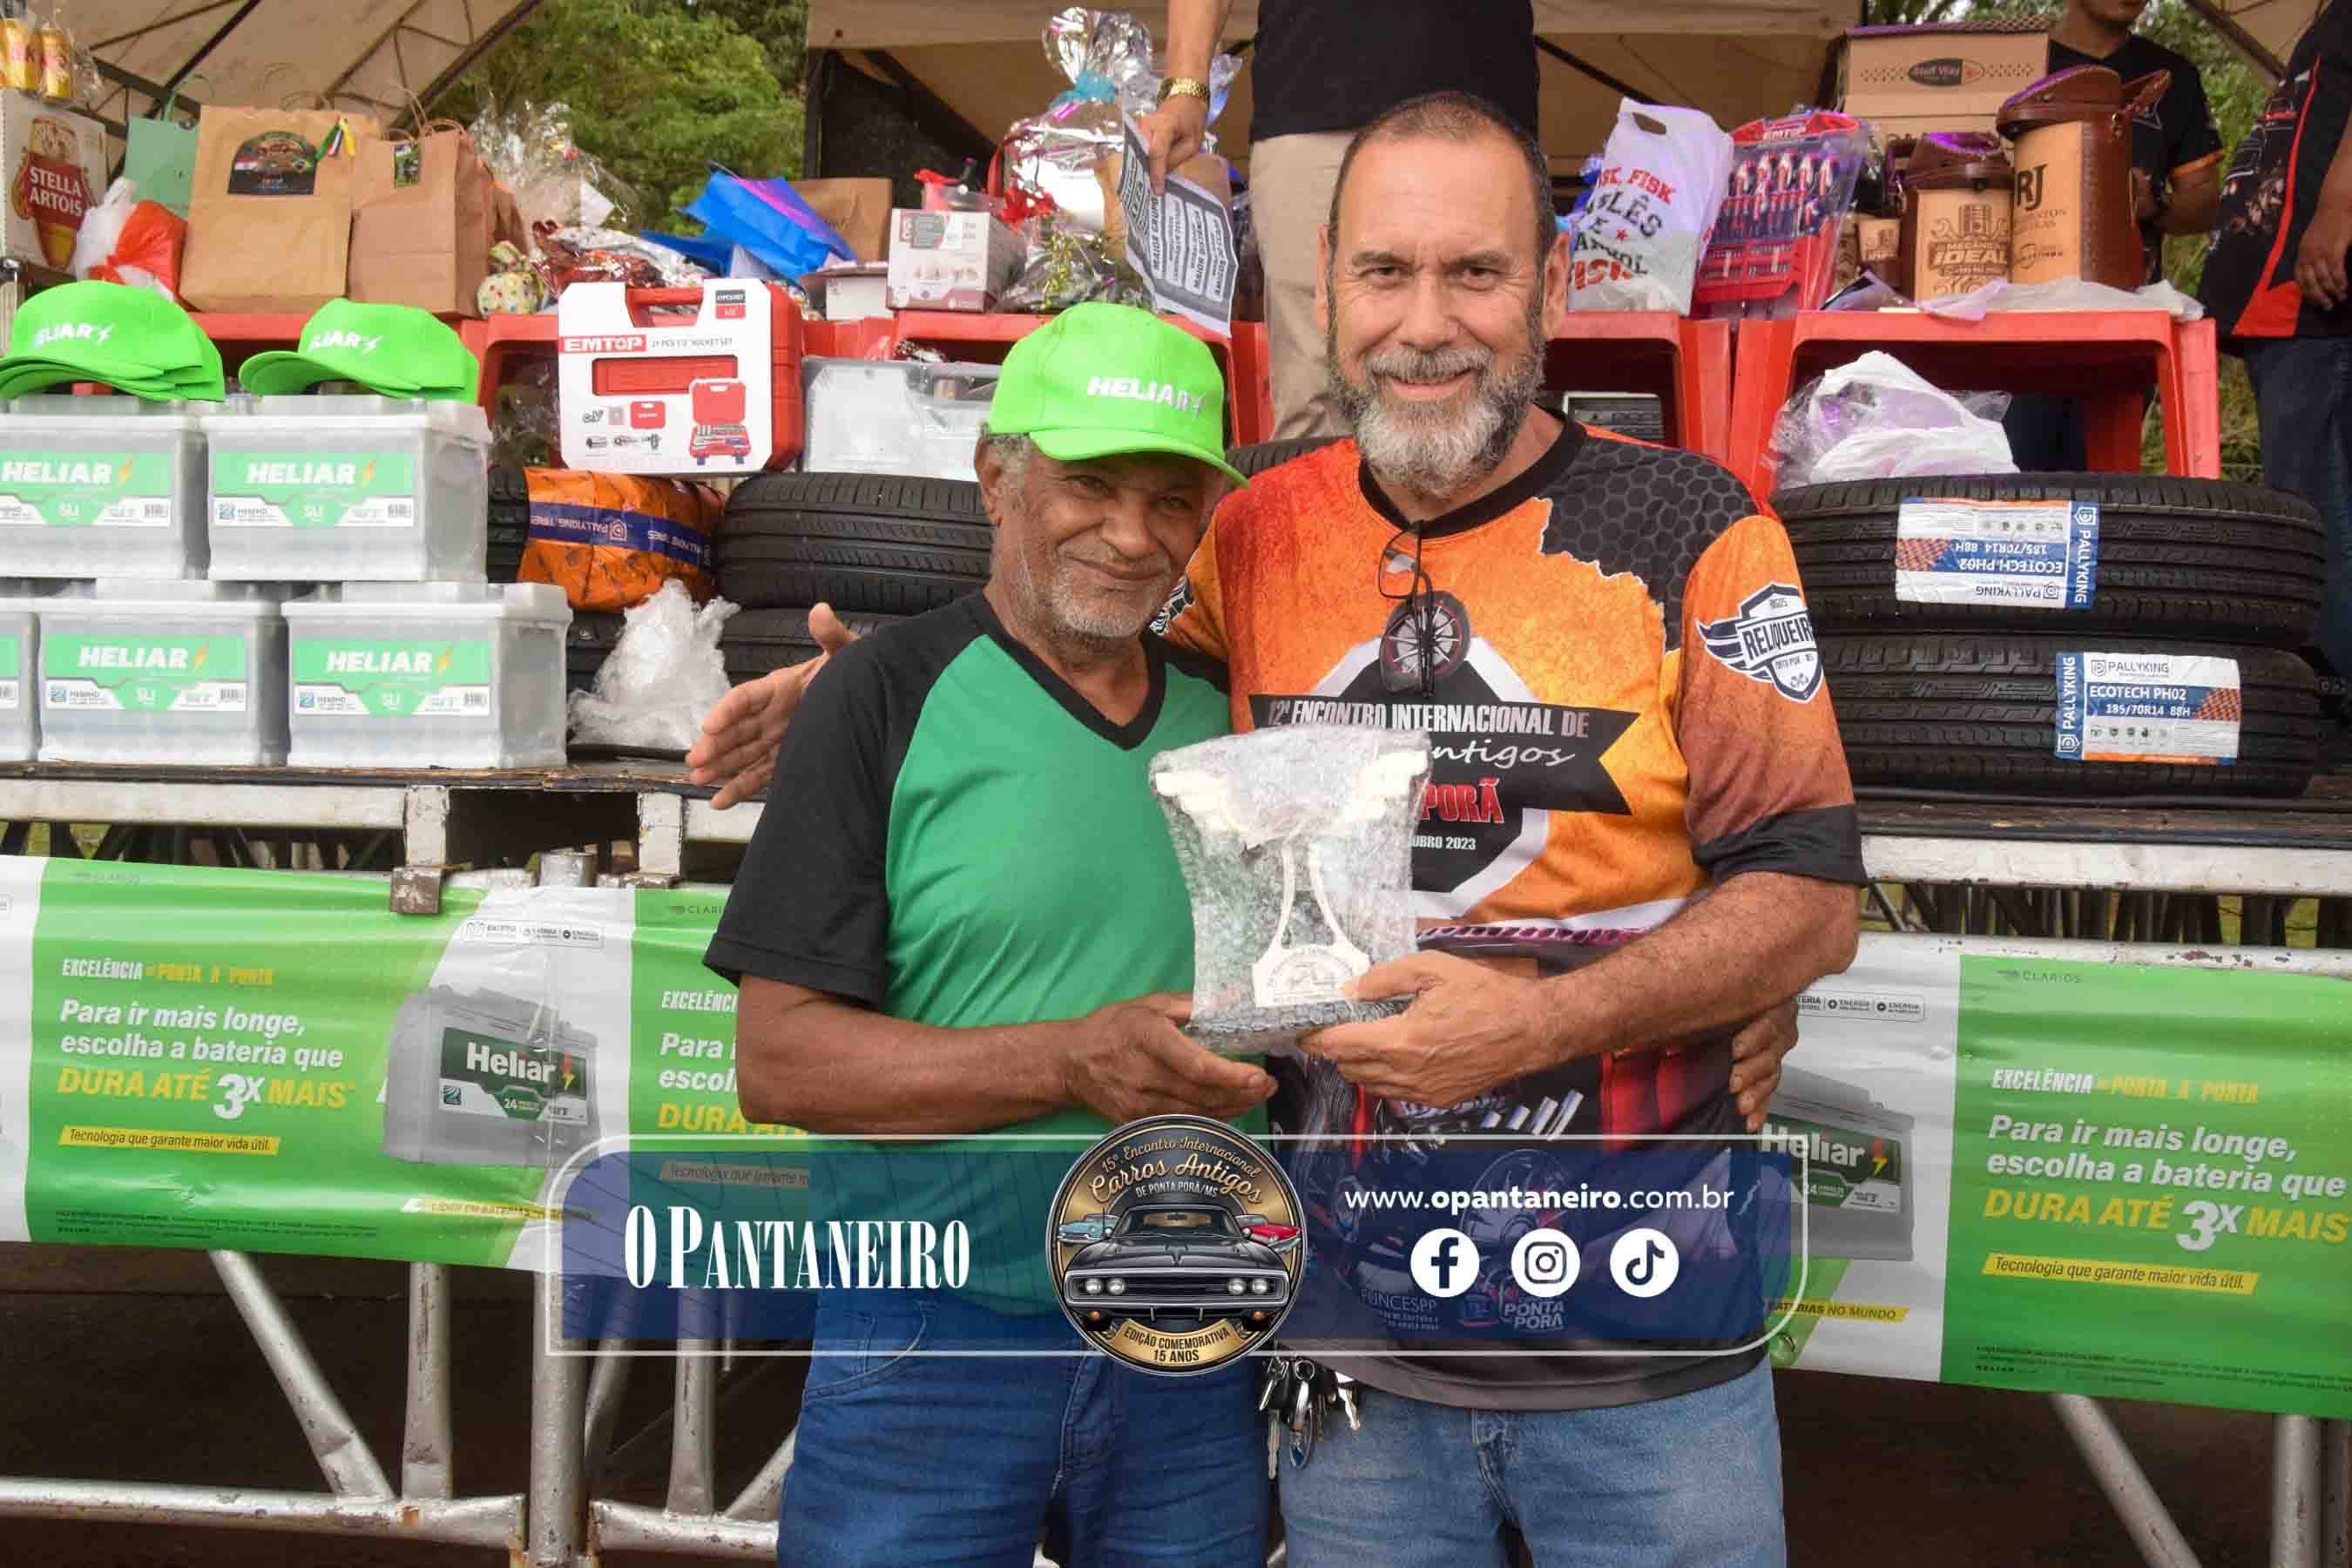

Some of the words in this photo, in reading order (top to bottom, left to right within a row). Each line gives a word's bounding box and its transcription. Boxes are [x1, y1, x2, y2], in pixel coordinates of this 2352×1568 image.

[30, 167, 82, 197] STELLA
[1628, 167, 1673, 206] FISK
[2017, 163, 2048, 211] RJ
[29, 187, 84, 216] ARTOIS
[564, 336, 642, 353] EMTOP
[1087, 375, 1188, 411] HELIAR
[2, 461, 112, 485] HELIAR
[247, 461, 356, 484] HELIAR
[1956, 542, 1978, 551] 88H
[1985, 543, 2046, 555] 185/70R14
[1960, 558, 1995, 570] PH02
[1999, 558, 2063, 573] ECOTECH
[2075, 529, 2092, 604] PALLYKING
[1976, 585, 2040, 598] PALLYKING
[1742, 617, 1813, 660] RELIQUEIR
[78, 645, 189, 669] HELIAR
[327, 651, 433, 673] HELIAR
[2108, 661, 2169, 673] PALLYKING
[2063, 657, 2077, 729] PALLYKING
[2091, 686, 2150, 699] ECOTECH
[2153, 687, 2187, 700] PH02
[1292, 700, 1387, 727] ENCONTRO
[1392, 704, 1555, 736] INTERNACIONAL
[1561, 712, 1589, 738] DE
[2105, 703, 2165, 716] 185/70R14
[2170, 706, 2190, 716] 88H
[1431, 739, 1576, 768] ntigos
[1421, 778, 1505, 823] PORÃ
[1410, 835, 1443, 849] UBRO
[1446, 836, 1477, 850] 2023
[62, 957, 142, 979] EXCELÊNCIA
[661, 990, 739, 1013] EXCELÊNCI
[1798, 996, 1821, 1004] TERIA
[61, 999, 122, 1025] Para
[129, 1002, 148, 1026] ir
[153, 1005, 217, 1029] mais
[224, 1007, 305, 1037] longe,
[61, 1034, 163, 1058] escolha
[169, 1042, 185, 1059] a
[192, 1037, 287, 1065] bateria
[294, 1046, 343, 1071] que
[660, 1031, 724, 1060] Para
[467, 1041, 557, 1084] Heliar
[57, 1067, 146, 1097] DURA
[151, 1068, 210, 1100] ATÉ
[659, 1067, 737, 1093] escol
[1992, 1068, 2092, 1094] EXCELÊNCIA
[658, 1102, 747, 1134] DURA
[70, 1128, 125, 1146] Tecnologia
[128, 1133, 147, 1147] que
[150, 1134, 192, 1149] garante
[193, 1133, 224, 1149] maior
[226, 1135, 249, 1150] vida
[251, 1136, 271, 1151] útil.
[1761, 1123, 1865, 1166] Heliar
[1988, 1115, 2063, 1144] Para
[2072, 1119, 2097, 1144] ir
[2104, 1123, 2182, 1151] mais
[2193, 1125, 2298, 1164] longe,
[1986, 1151, 2114, 1184] escolha
[2125, 1163, 2144, 1183] a
[2153, 1159, 2273, 1193] bateria
[2281, 1171, 2347, 1200] que
[1984, 1189, 2092, 1227] DURA
[2098, 1192, 2174, 1231] ATÉ
[2245, 1207, 2349, 1243] MAIS
[1995, 1255, 2063, 1278] Tecnologia
[2066, 1261, 2092, 1278] que
[2094, 1264, 2145, 1284] garante
[2147, 1265, 2185, 1285] maior
[2186, 1271, 2217, 1288] vida
[2219, 1273, 2245, 1290] útil.
[1505, 1301, 1565, 1316] PONTA
[1774, 1302, 1824, 1315] ATRIAS
[1826, 1306, 1846, 1316] NO
[1848, 1308, 1896, 1319] MUNDO
